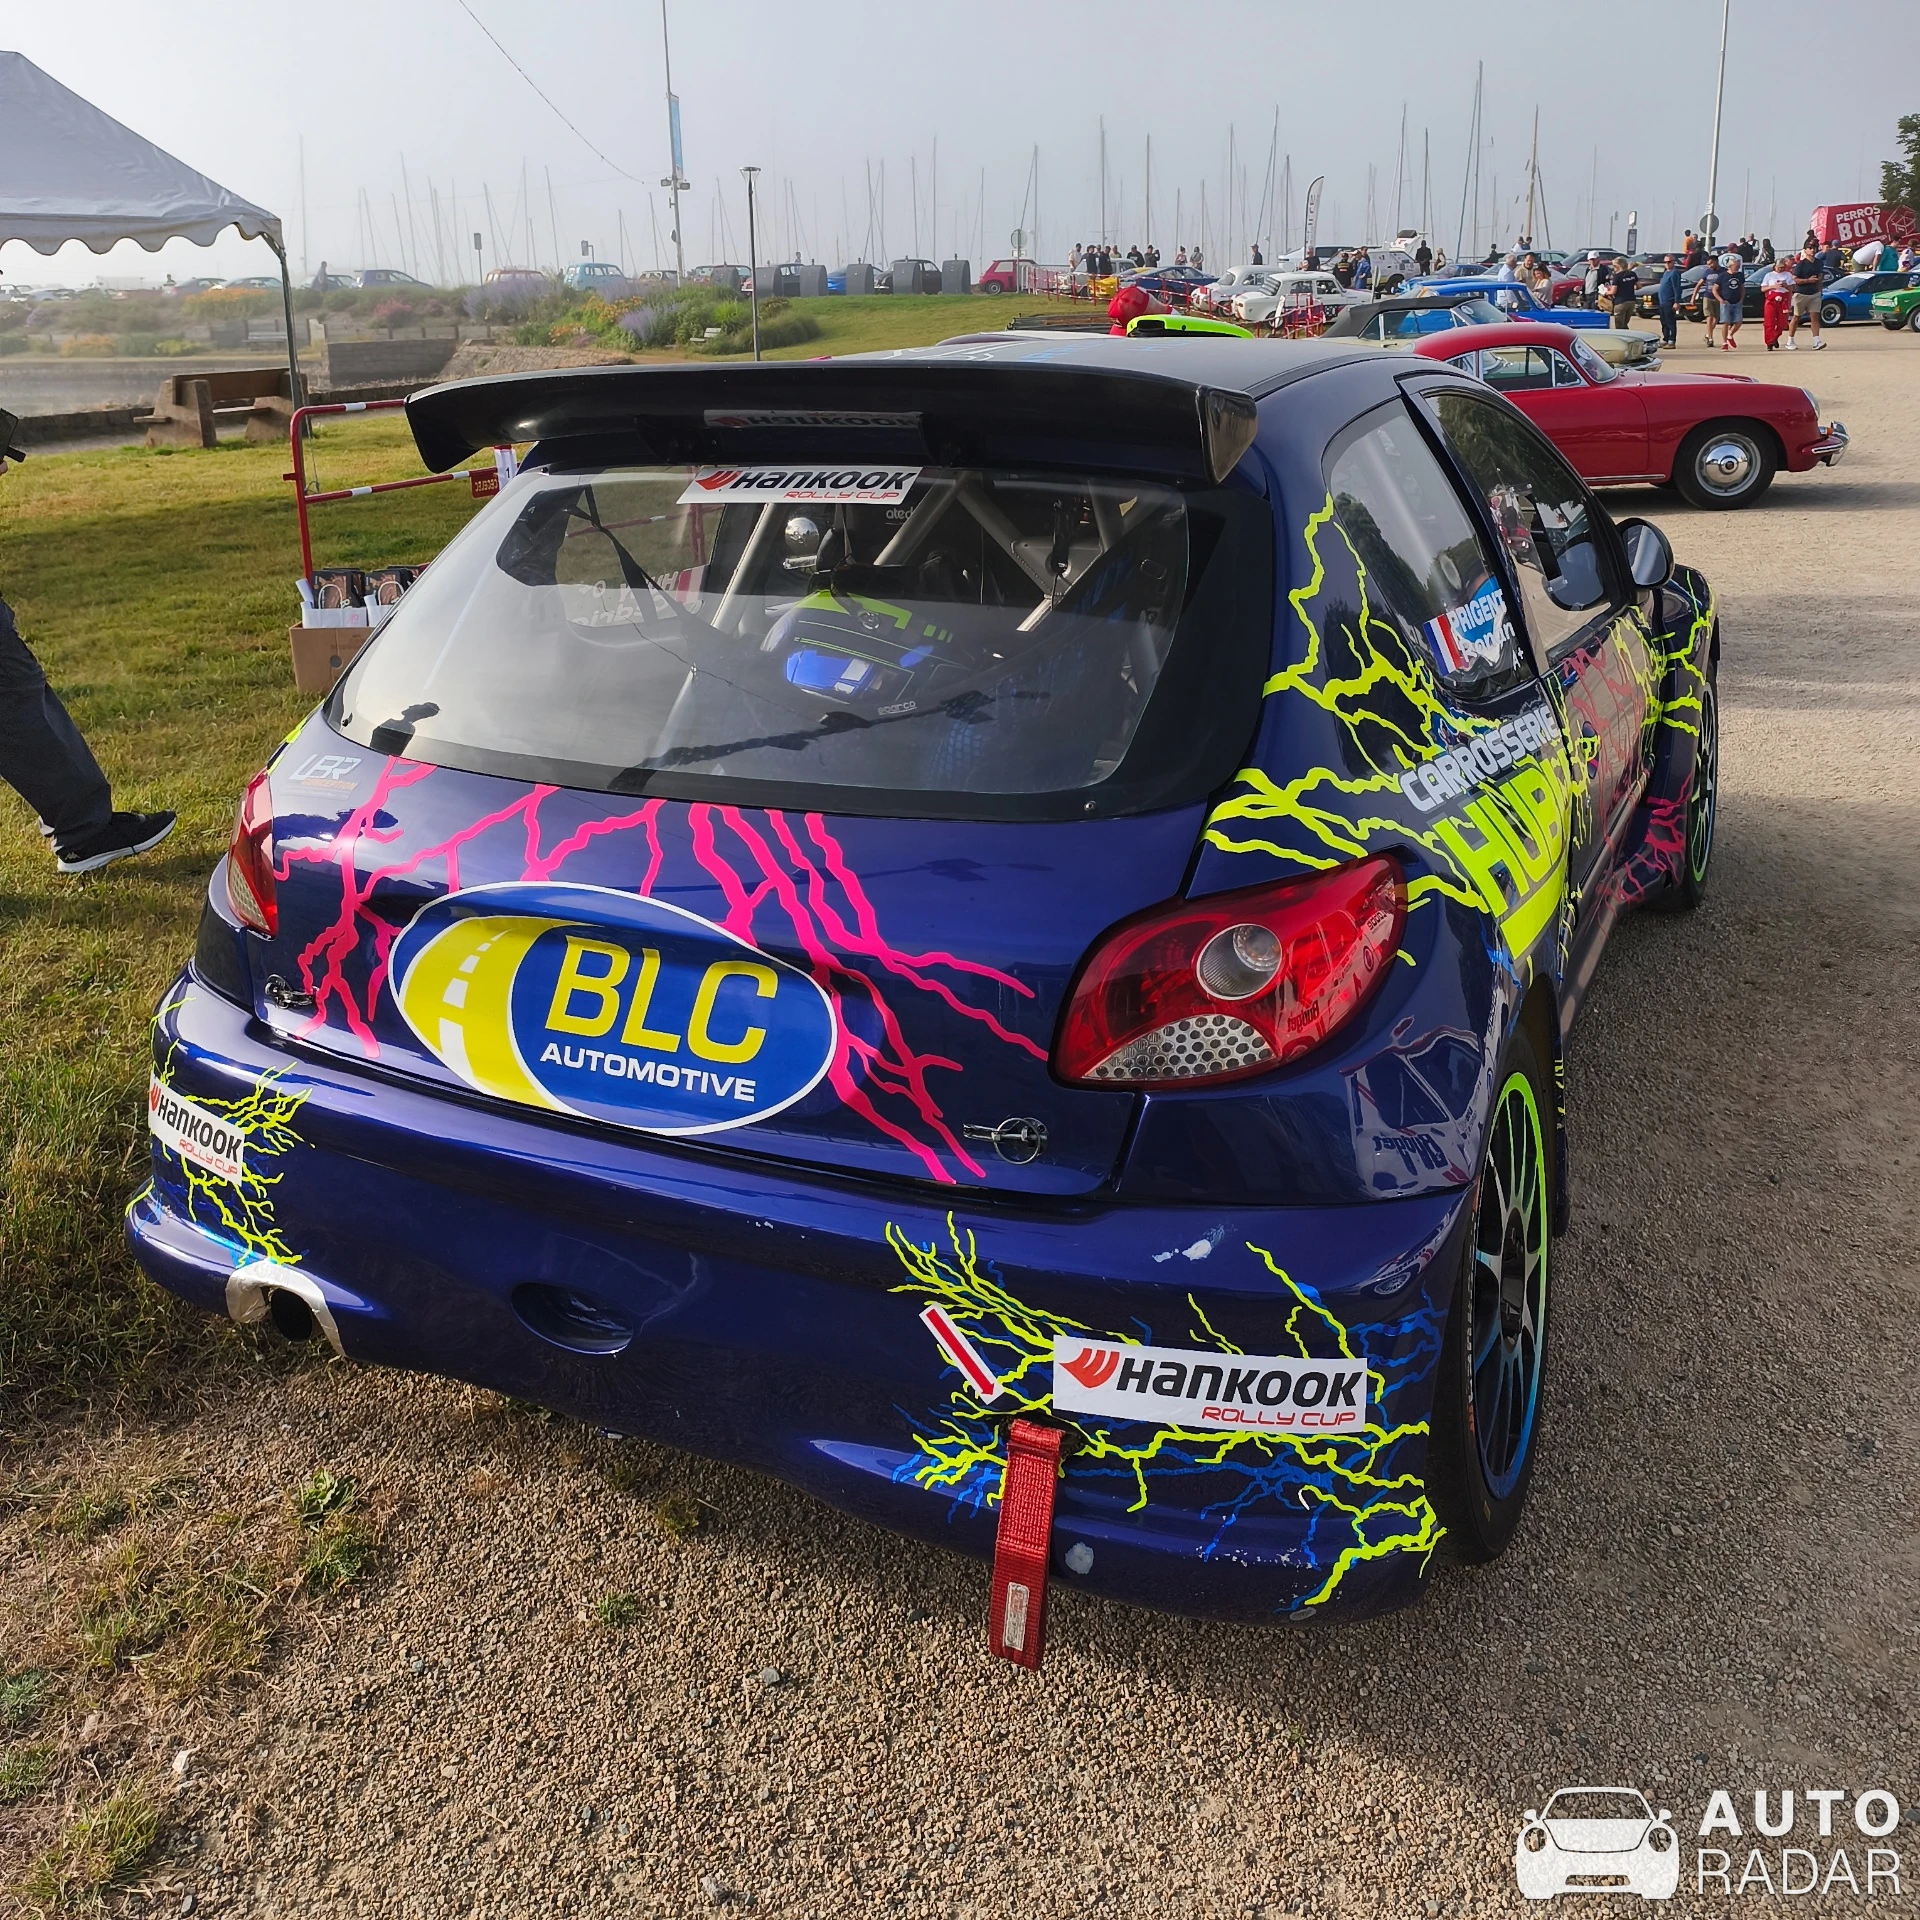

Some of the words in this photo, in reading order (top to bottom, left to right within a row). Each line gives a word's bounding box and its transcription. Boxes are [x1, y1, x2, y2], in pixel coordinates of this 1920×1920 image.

[1836, 205, 1881, 223] PERROS
[1838, 215, 1883, 242] BOX
[505, 467, 511, 479] 1
[729, 471, 917, 490] HANKOOK
[855, 491, 899, 499] CUP
[1446, 589, 1503, 632] PRIGENT
[1460, 622, 1516, 662] Ronan
[1400, 705, 1562, 812] CARROSSERIE
[545, 935, 778, 1064] BLC
[540, 1043, 756, 1102] AUTOMOTIVE
[157, 1094, 242, 1163] HANKOOK
[214, 1158, 238, 1175] CUP
[1116, 1357, 1363, 1407] HANKOOK
[1301, 1412, 1356, 1427] CUP
